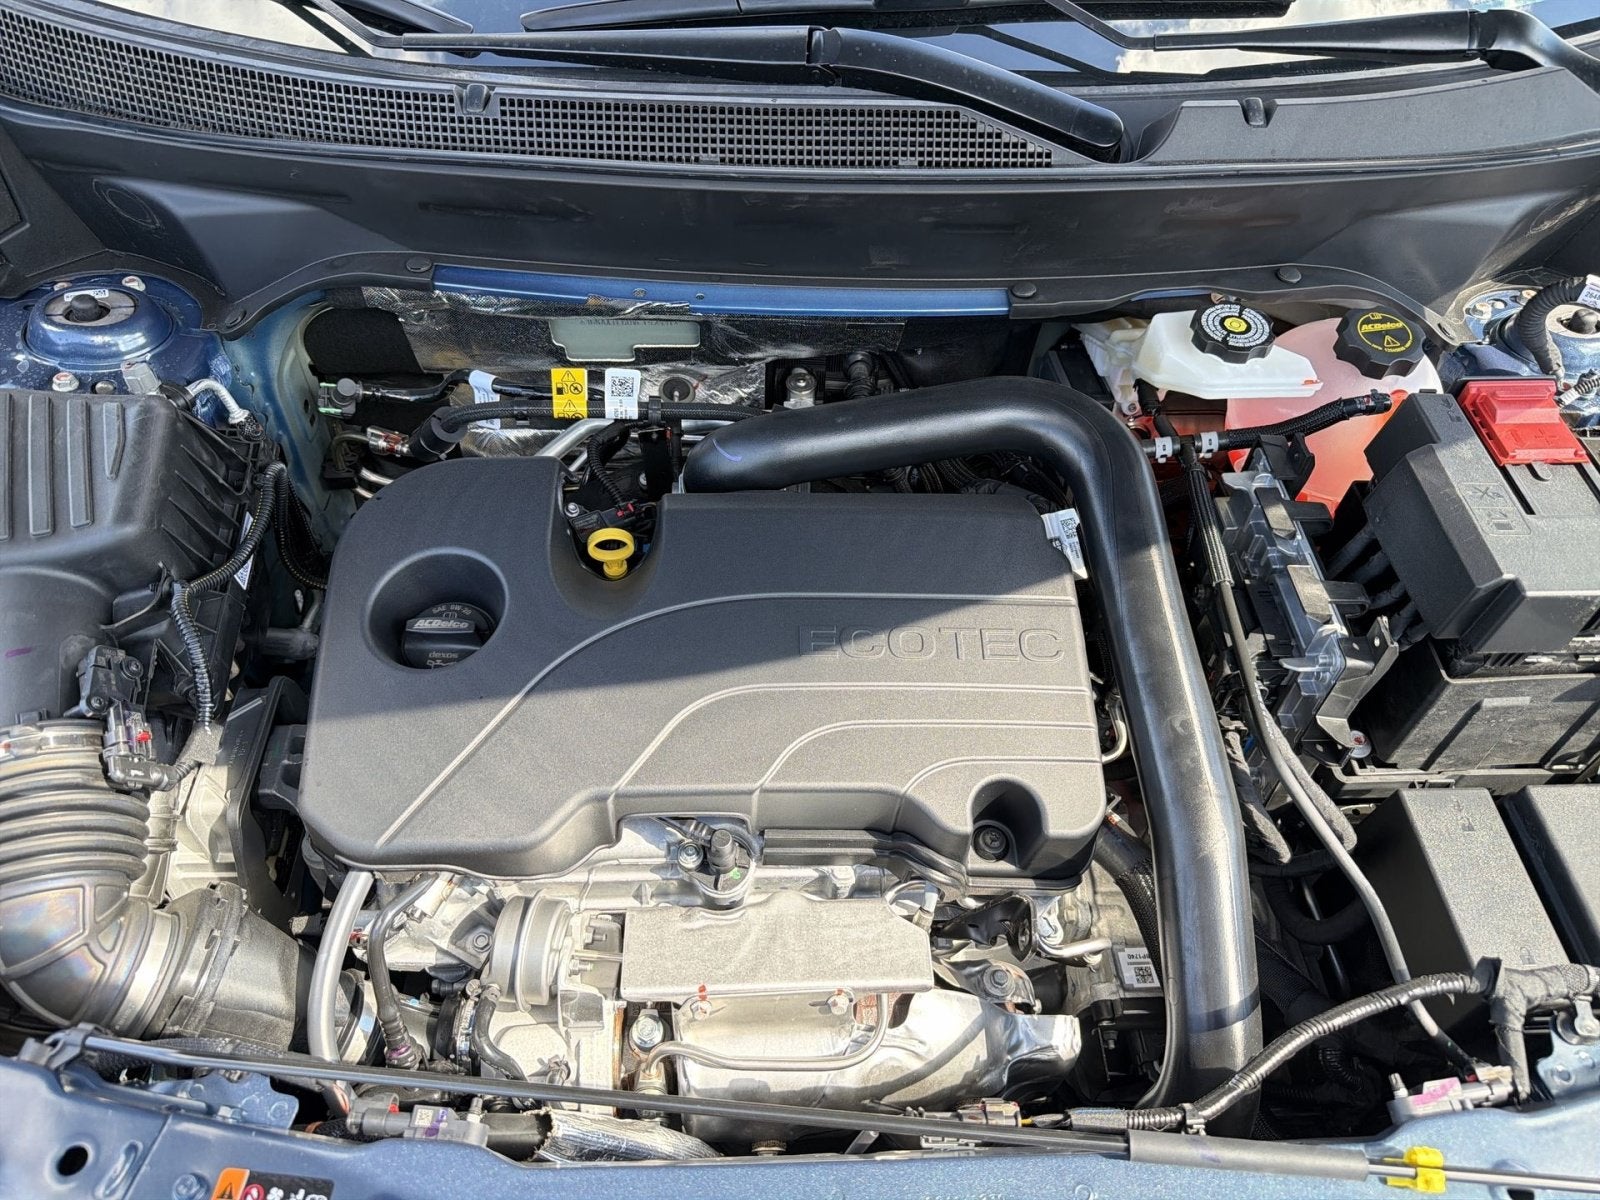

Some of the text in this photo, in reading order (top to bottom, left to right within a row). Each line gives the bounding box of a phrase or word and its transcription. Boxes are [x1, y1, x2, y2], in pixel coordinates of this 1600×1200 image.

[1361, 322, 1403, 332] ACDelco
[432, 605, 447, 614] SAE
[413, 619, 469, 629] ACDelco
[799, 625, 1064, 662] ECOTEC
[429, 651, 459, 659] dexos
